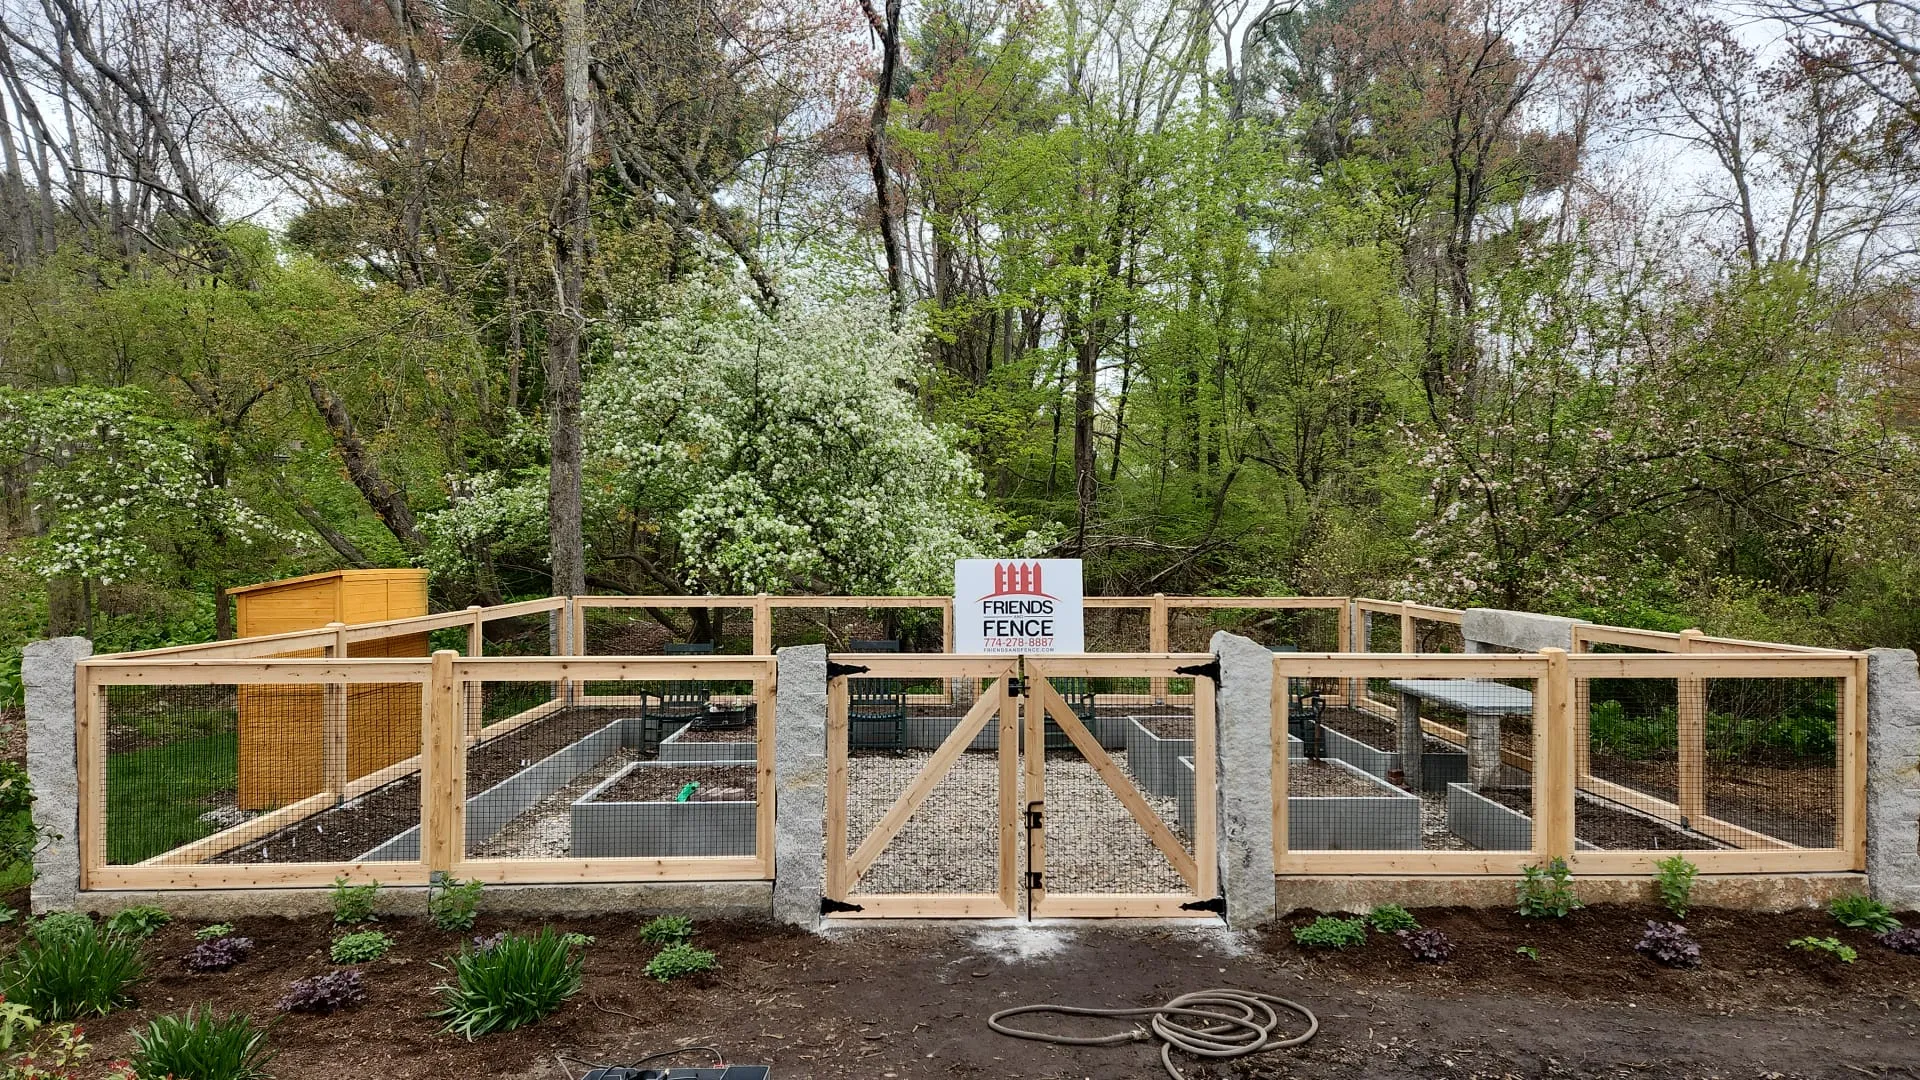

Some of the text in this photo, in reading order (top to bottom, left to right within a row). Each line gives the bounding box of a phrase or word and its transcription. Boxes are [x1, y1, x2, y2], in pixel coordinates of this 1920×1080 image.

[983, 600, 1053, 614] FRIENDS
[983, 620, 1053, 637] FENCE
[984, 637, 1054, 647] 774-278-8887
